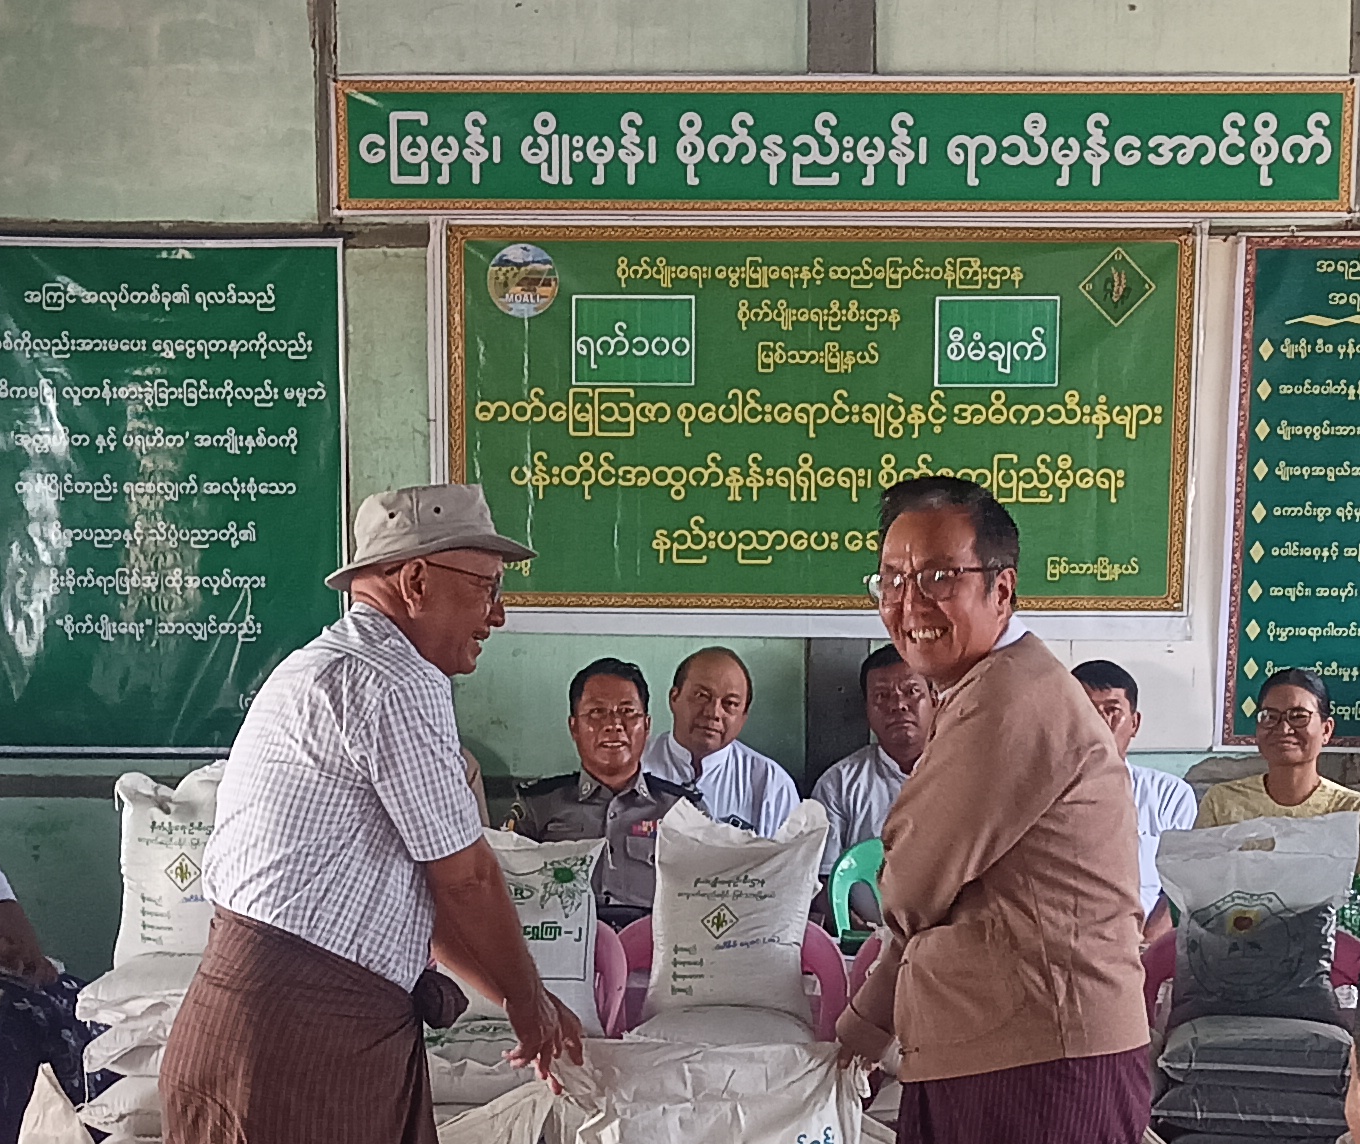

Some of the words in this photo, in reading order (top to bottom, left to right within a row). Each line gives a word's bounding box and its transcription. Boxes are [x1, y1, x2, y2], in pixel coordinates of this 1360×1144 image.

[360, 111, 501, 187] မြေမှန်၊
[522, 110, 656, 188] မျိုးမှန်၊
[676, 110, 926, 187] စိုက်နည်းမှန်၊
[946, 110, 1332, 189] ရာသီမှန်အောင်စိုက်
[616, 256, 712, 288] စိုက်ပျိုးရေး၊
[195, 284, 276, 312] ရလဒ်သည်
[504, 292, 542, 305] MOALI
[736, 300, 901, 331] စိုက်ပျိုးရေးဦးစီးဌာန
[757, 342, 879, 374] မြစ်သားမြို့နယ်
[945, 326, 1048, 374] စီမံချက်
[676, 388, 948, 440] စုပေါင်းရောင်းချပွဲနှင့်
[952, 389, 1164, 440] အဓိကသီးနှံများ
[95, 427, 118, 455] နှင့်
[651, 516, 839, 565] နည်းပညာပေး
